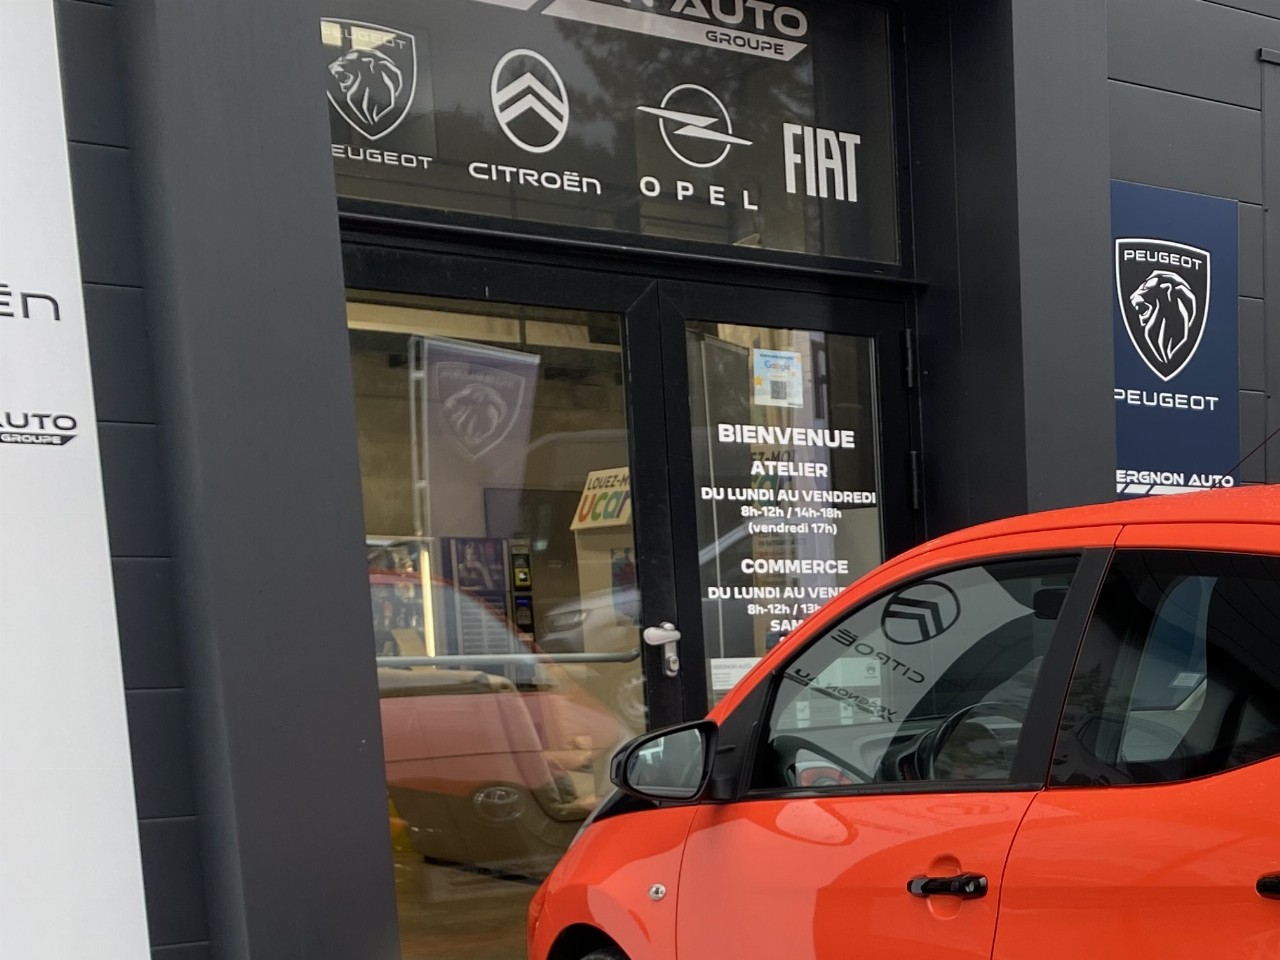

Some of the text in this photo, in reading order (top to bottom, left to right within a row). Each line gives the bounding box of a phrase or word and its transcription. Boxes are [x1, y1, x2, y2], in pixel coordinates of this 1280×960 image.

[668, 0, 808, 37] AUTO
[705, 30, 784, 56] GROUPE
[331, 144, 433, 169] EUGEOT
[783, 122, 861, 202] FIAT
[639, 176, 758, 210] OPEL
[1123, 250, 1203, 271] PEUGEOT
[0, 411, 77, 431] UTO
[1, 433, 62, 445] GROUPE
[717, 423, 856, 448] BIENVENUE
[751, 460, 829, 478] ATELIER
[1115, 469, 1234, 488] ERGNON AUTO
[701, 487, 877, 504] DU LUNDI AU VENDREDI
[741, 505, 785, 518] 8h-12h
[794, 507, 842, 519] 14h-18h
[748, 522, 838, 535] (vendredi 17h)
[740, 559, 849, 575] COMMERCE
[708, 586, 731, 599] DU
[734, 587, 780, 599] LUNDI
[783, 587, 806, 599] AU
[747, 603, 790, 615] 8h-12h
[801, 603, 824, 615] 13h
